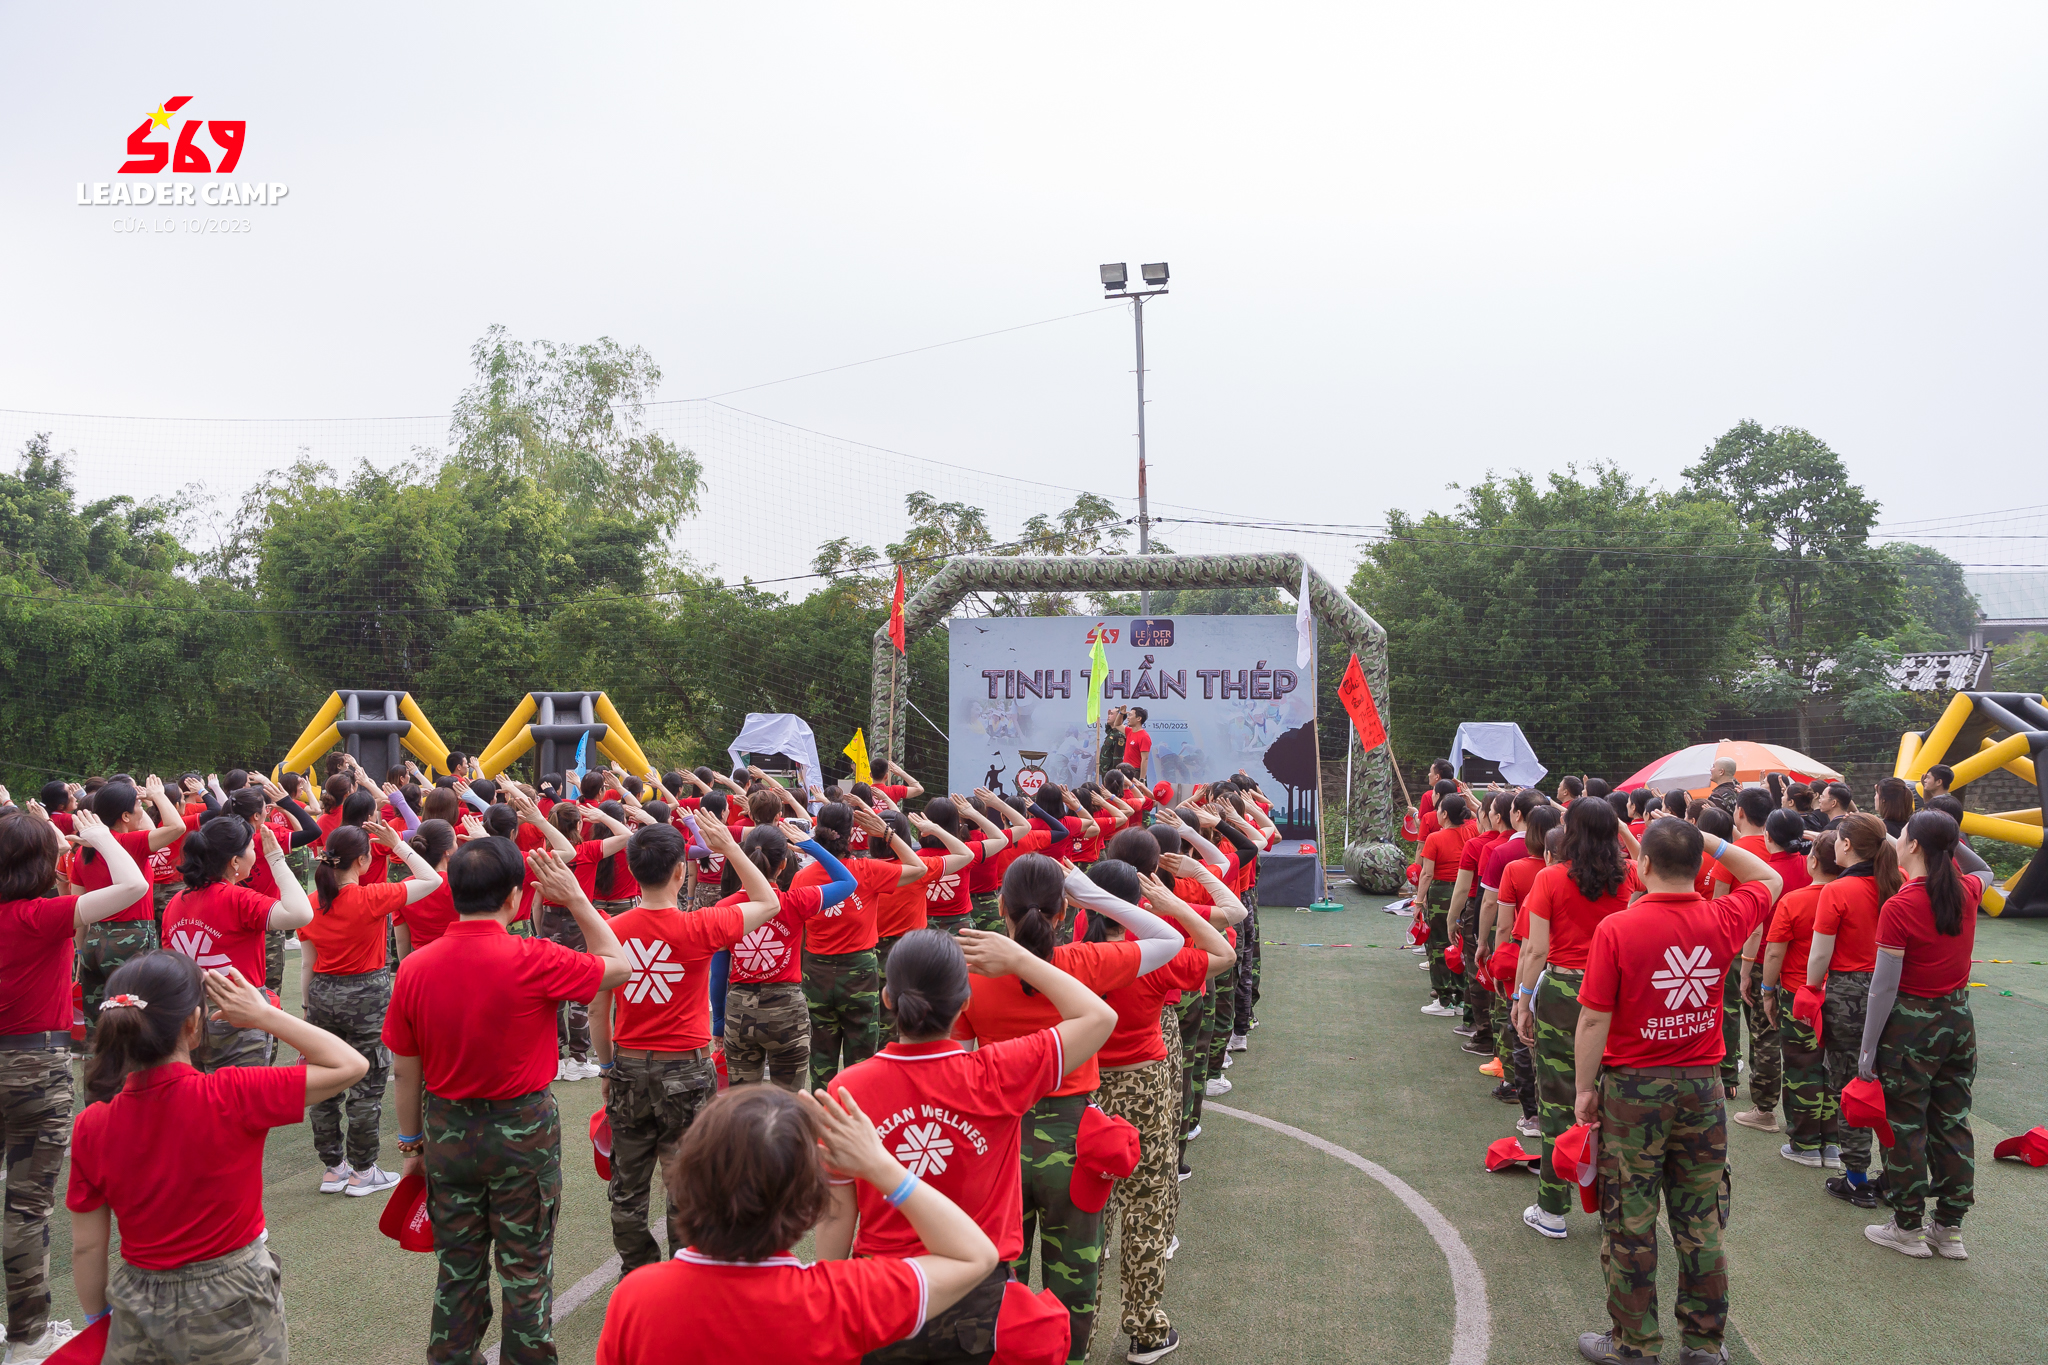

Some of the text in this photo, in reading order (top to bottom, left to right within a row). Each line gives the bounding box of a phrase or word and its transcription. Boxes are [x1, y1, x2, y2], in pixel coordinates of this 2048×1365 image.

[981, 669, 1071, 699] TINH
[1196, 660, 1298, 699] THÉP
[1152, 721, 1188, 730] 15/10/2023
[1647, 1007, 1717, 1028] SIBERIAN
[920, 1104, 988, 1155] WELLNESS
